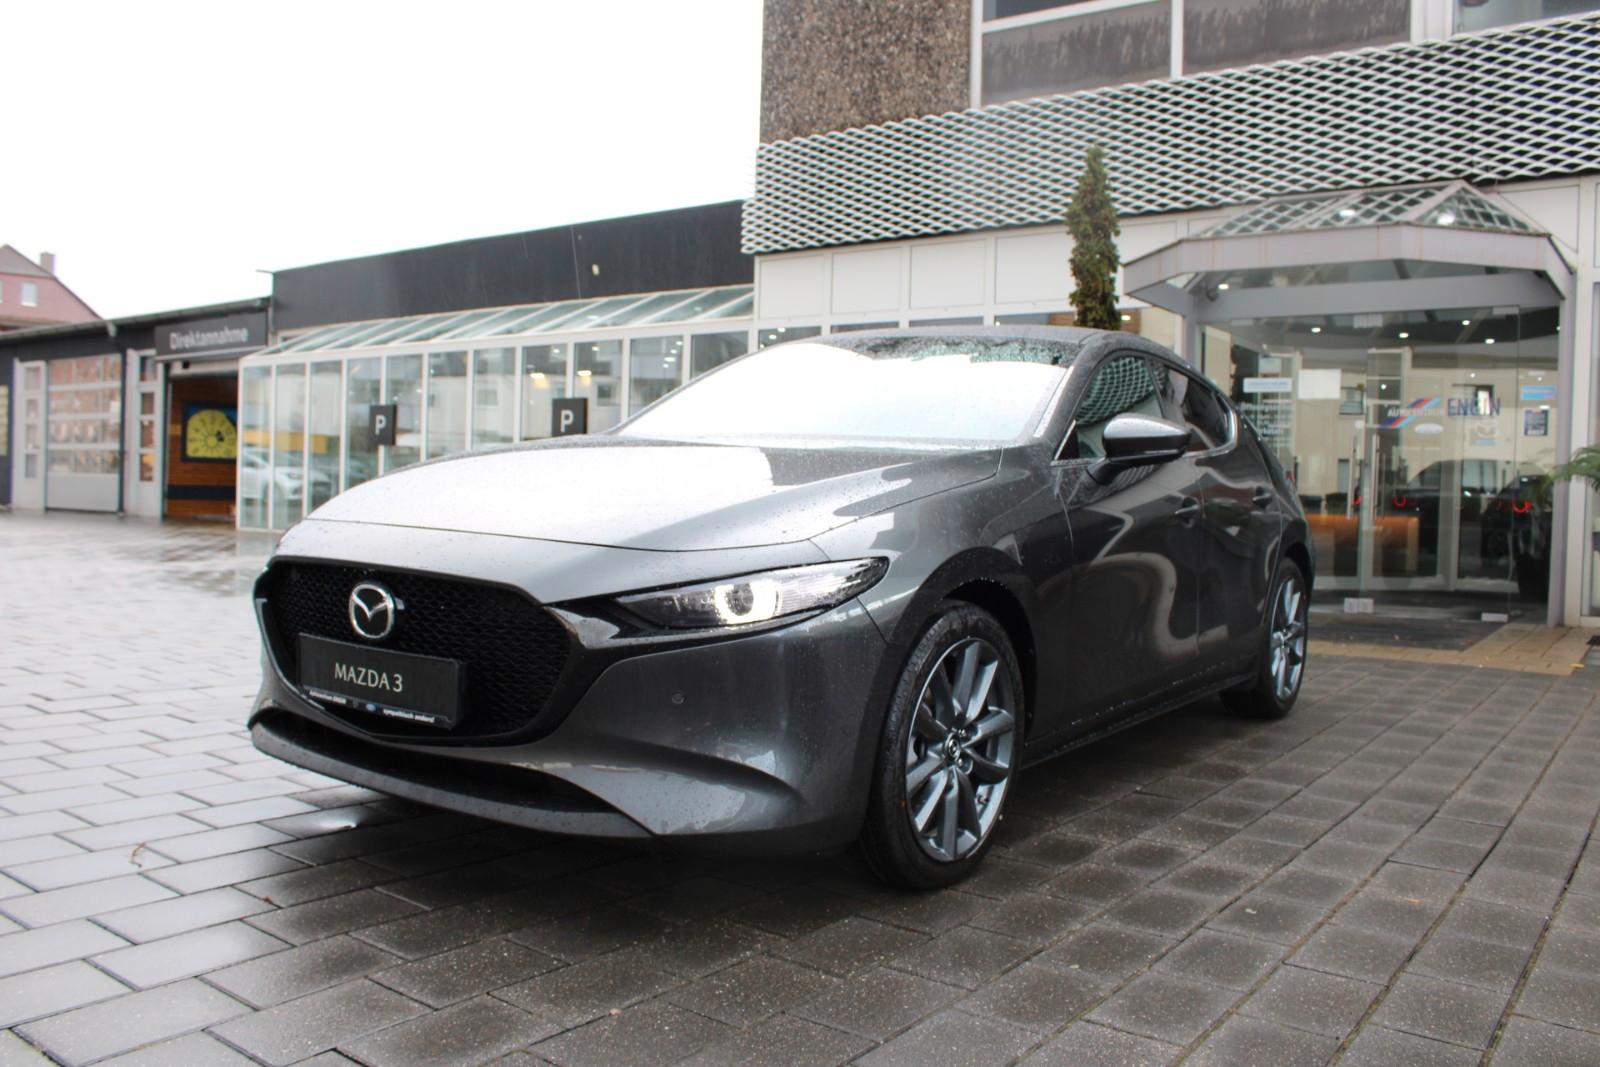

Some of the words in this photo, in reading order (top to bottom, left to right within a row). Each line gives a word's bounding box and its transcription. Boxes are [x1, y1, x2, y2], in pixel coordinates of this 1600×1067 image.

[169, 326, 249, 350] Direktannahme
[374, 414, 387, 436] P
[560, 409, 574, 433] P
[334, 662, 390, 691] MAZDA
[392, 673, 403, 693] 3
